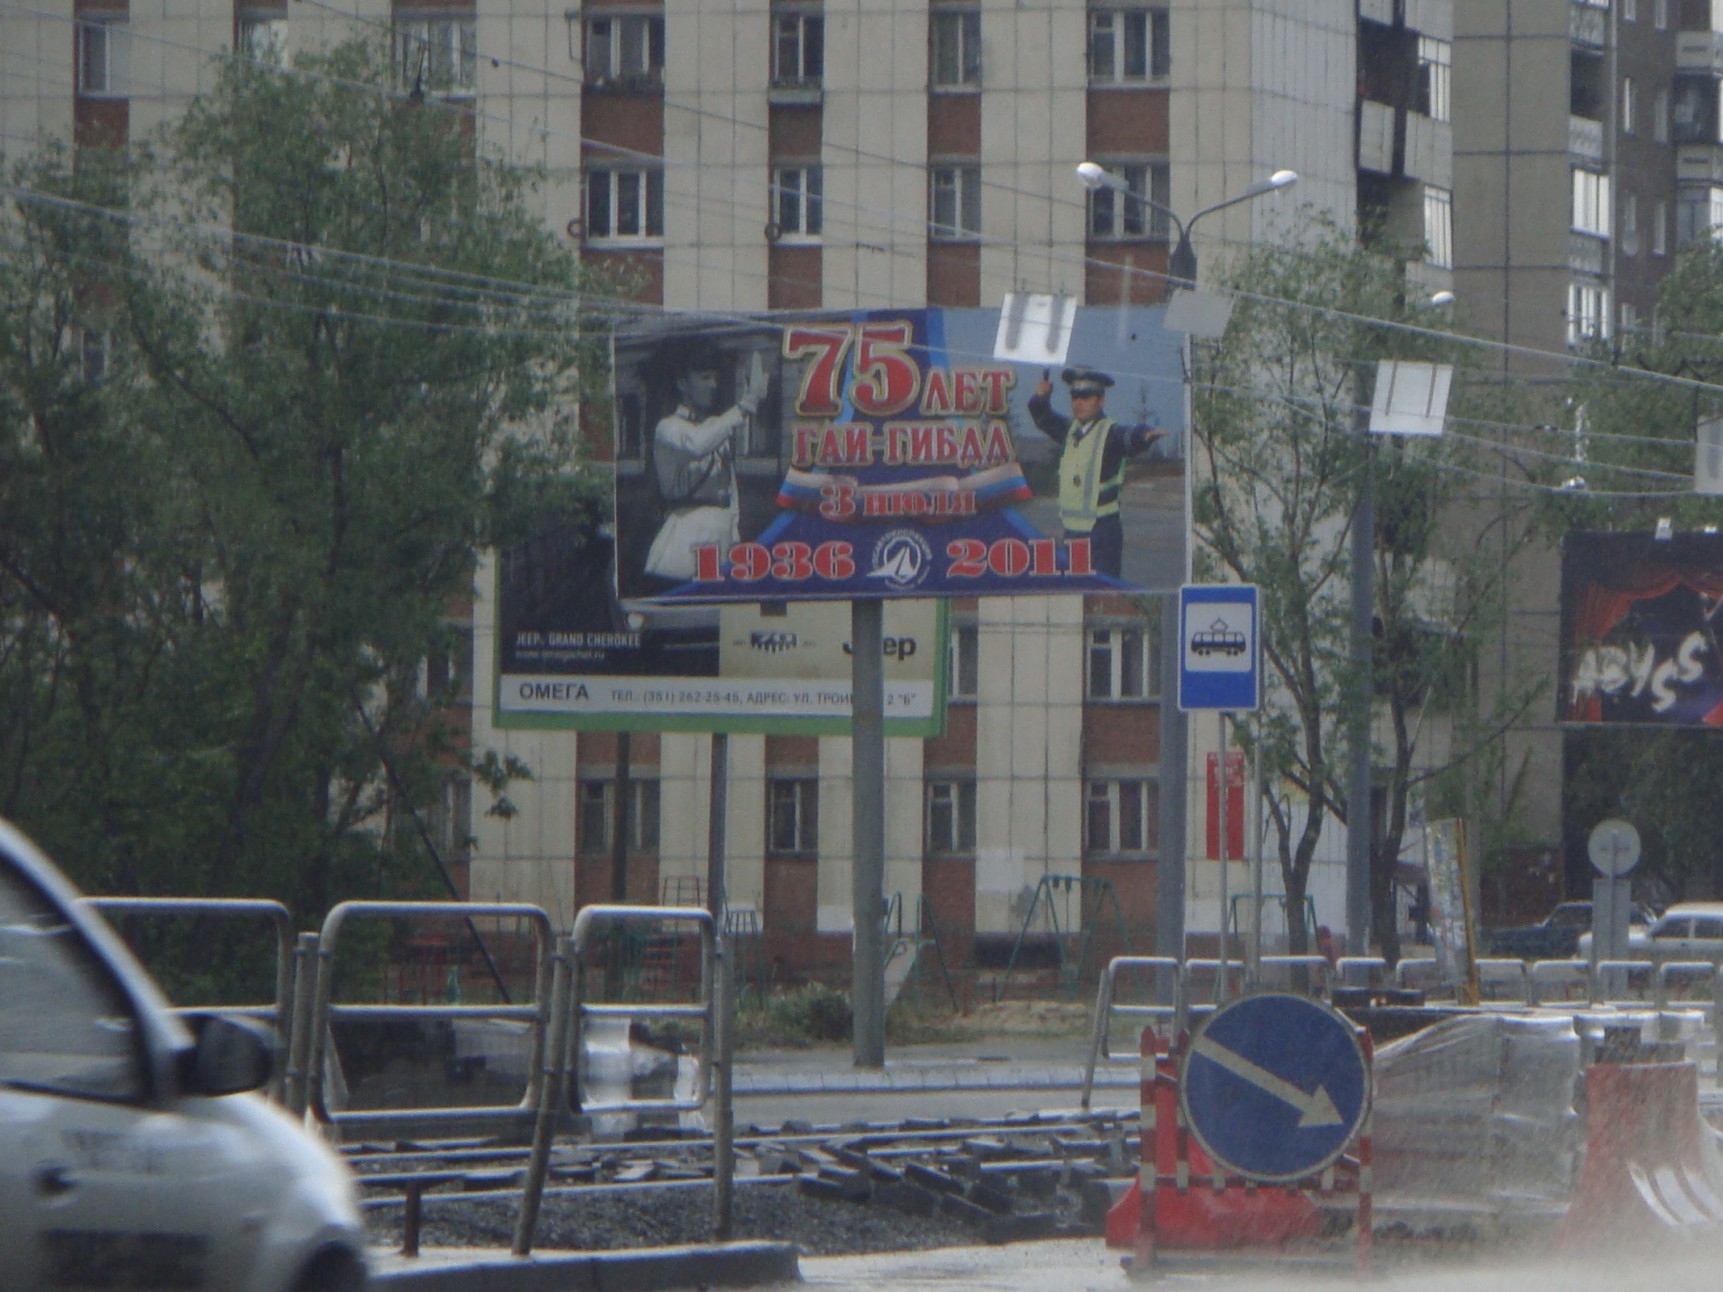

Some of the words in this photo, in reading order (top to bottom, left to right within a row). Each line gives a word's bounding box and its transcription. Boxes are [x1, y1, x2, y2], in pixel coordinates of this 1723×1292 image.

[782, 320, 920, 417] 75
[921, 365, 1016, 416] ЛЕТ
[792, 421, 1016, 467] ГАИ-ГИБДД
[819, 483, 857, 517] 3
[862, 486, 976, 517] июля
[692, 541, 855, 582] 1936
[947, 537, 1096, 577] 2011
[549, 632, 583, 646] GRAND
[588, 632, 640, 647] CHEROKEE
[1570, 630, 1707, 712] ABYSS
[519, 682, 589, 701] ОМЕГА
[793, 692, 812, 705] УЛ.
